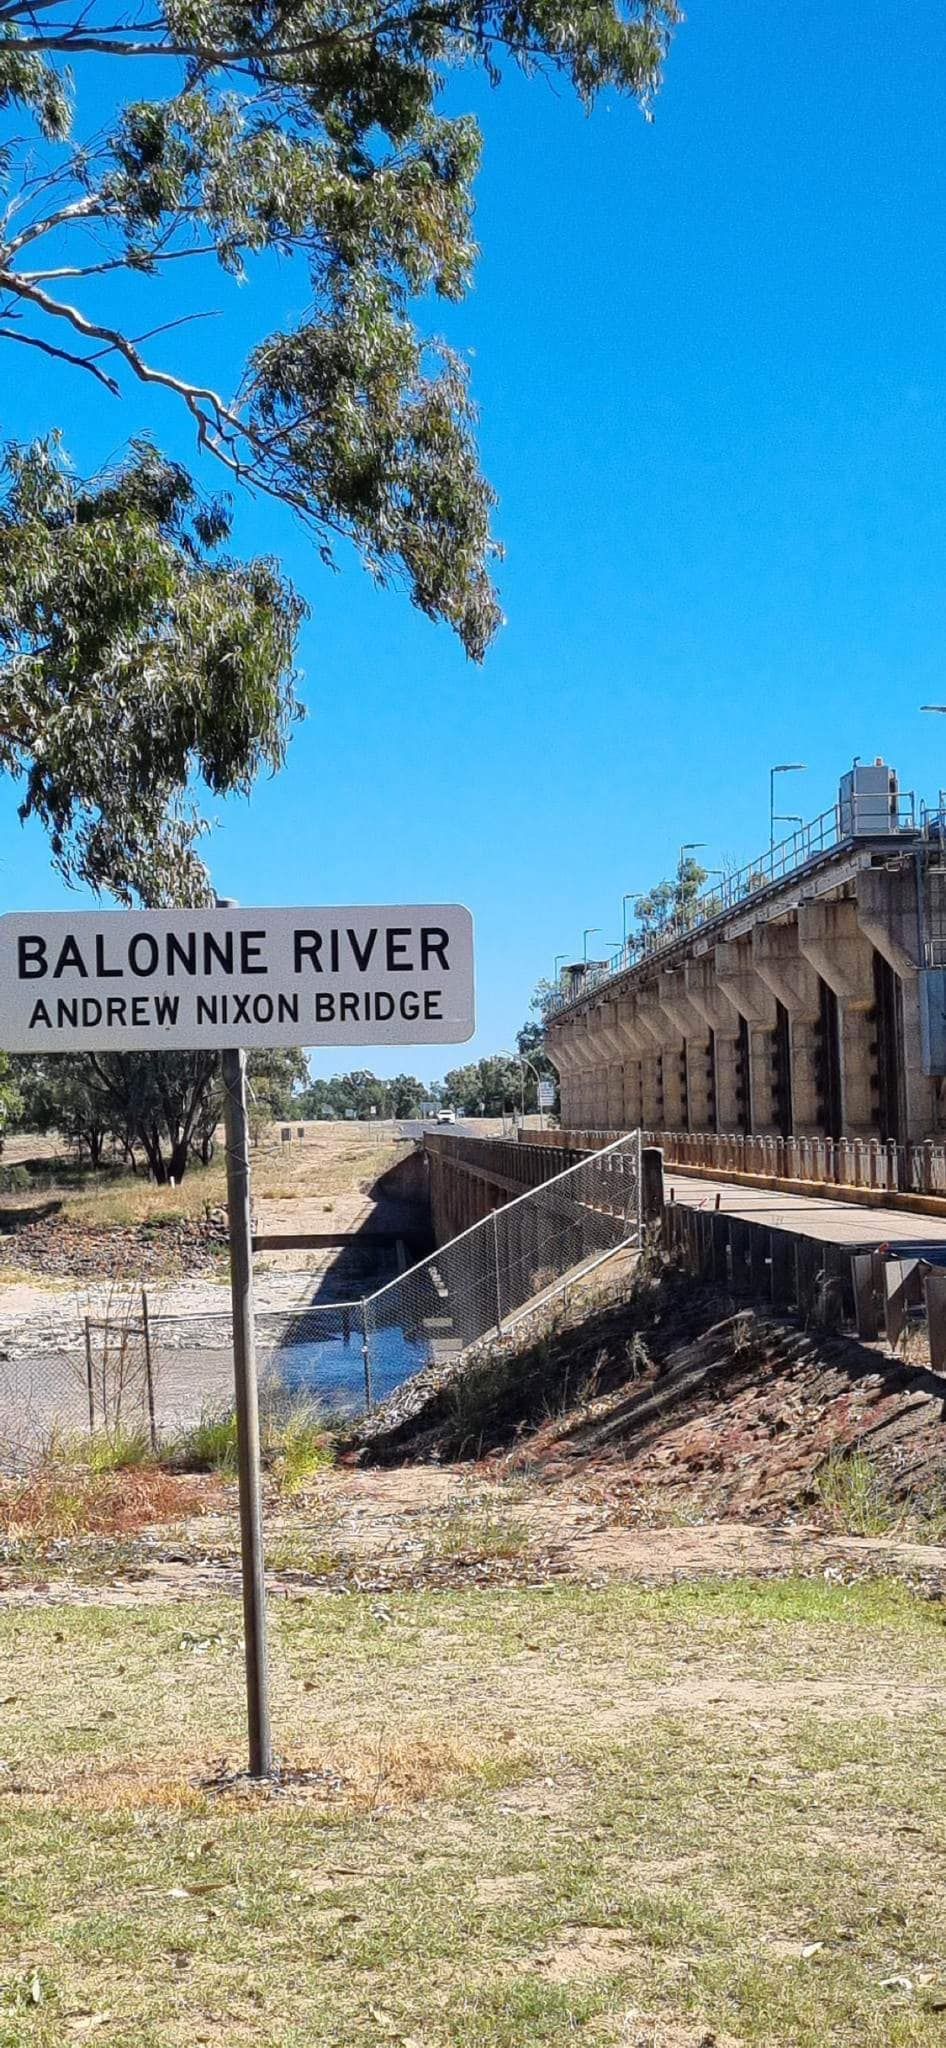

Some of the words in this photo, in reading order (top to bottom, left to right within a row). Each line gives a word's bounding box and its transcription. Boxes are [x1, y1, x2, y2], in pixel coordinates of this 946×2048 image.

[17, 930, 269, 980] BALONNE
[293, 927, 451, 974] RIVER
[28, 993, 180, 1029] ANDREW
[196, 992, 299, 1025] NIXON
[315, 990, 444, 1023] BRIDGE
